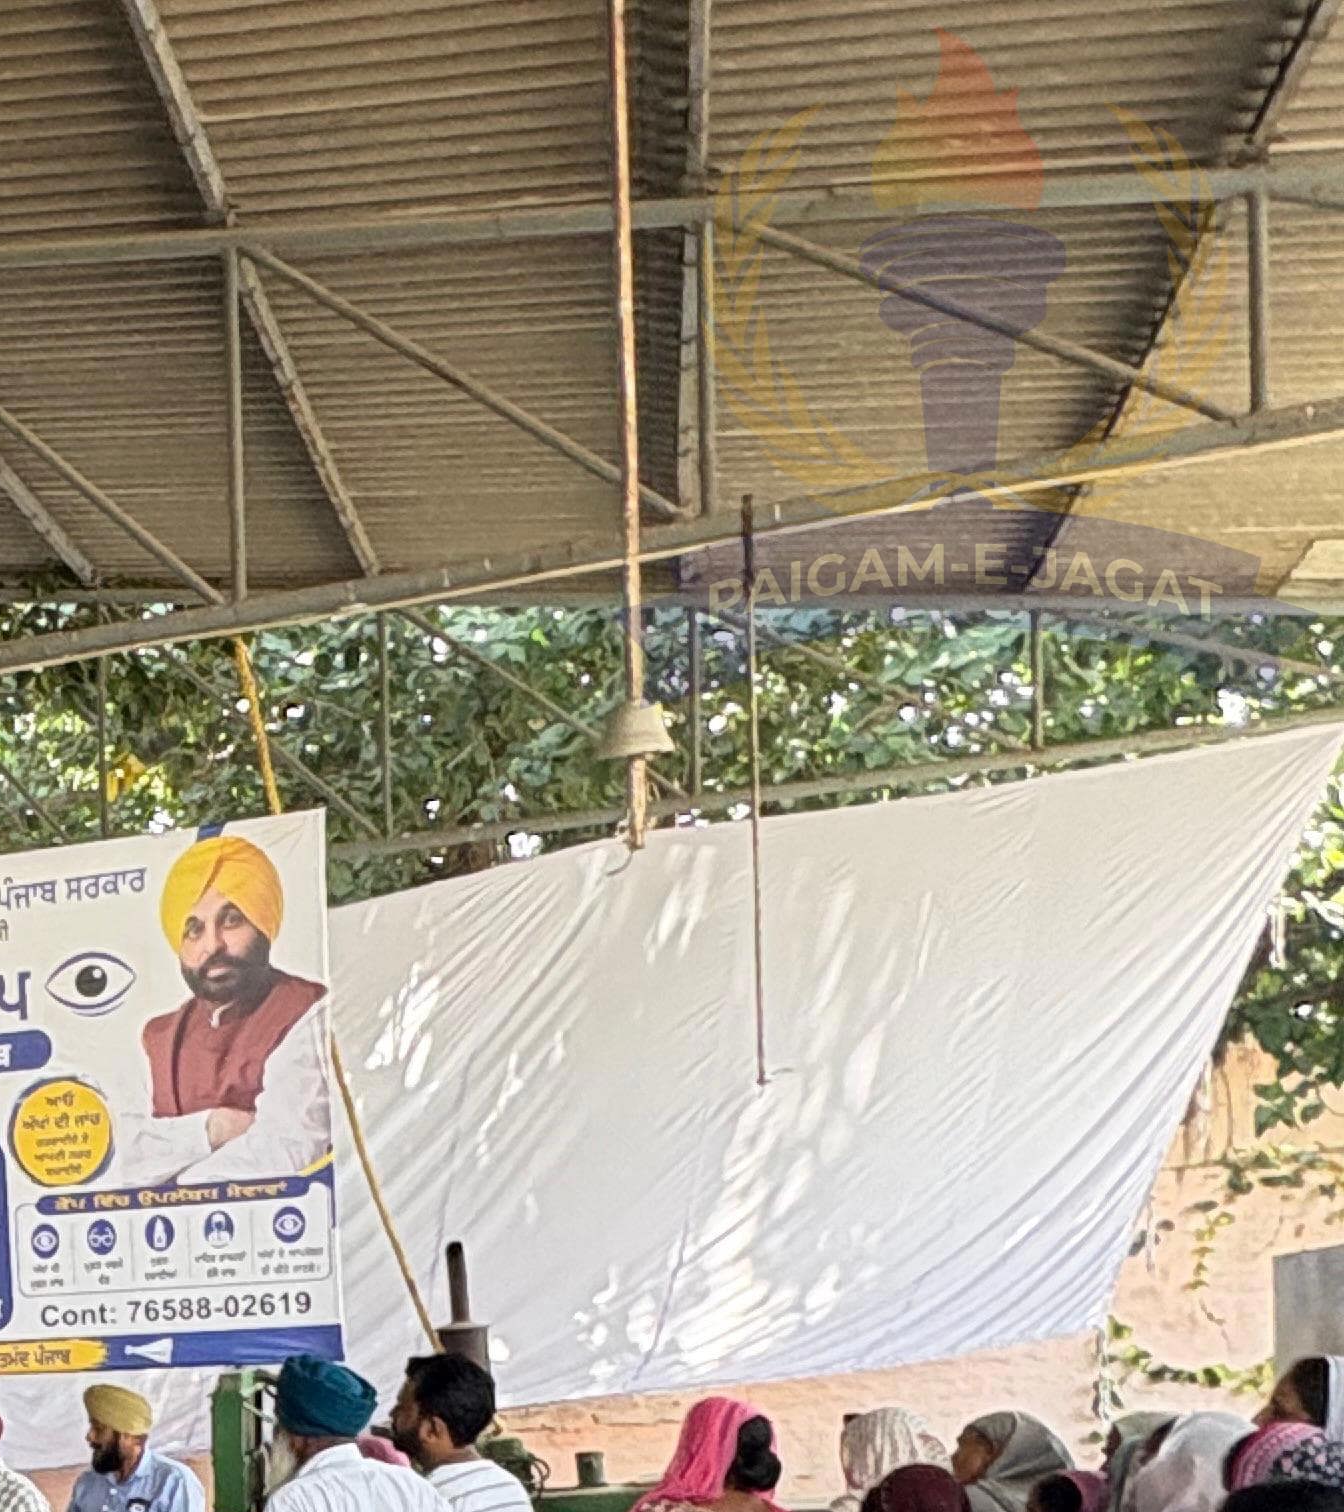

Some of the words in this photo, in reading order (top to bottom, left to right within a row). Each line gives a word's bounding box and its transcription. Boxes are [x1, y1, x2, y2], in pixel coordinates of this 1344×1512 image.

[65, 866, 147, 900] ਸਰਕਾਰ
[41, 1303, 116, 1328] Cont:
[125, 1291, 311, 1323] 76588-02619
[33, 1342, 72, 1366] ਪੰਜਾਬ
